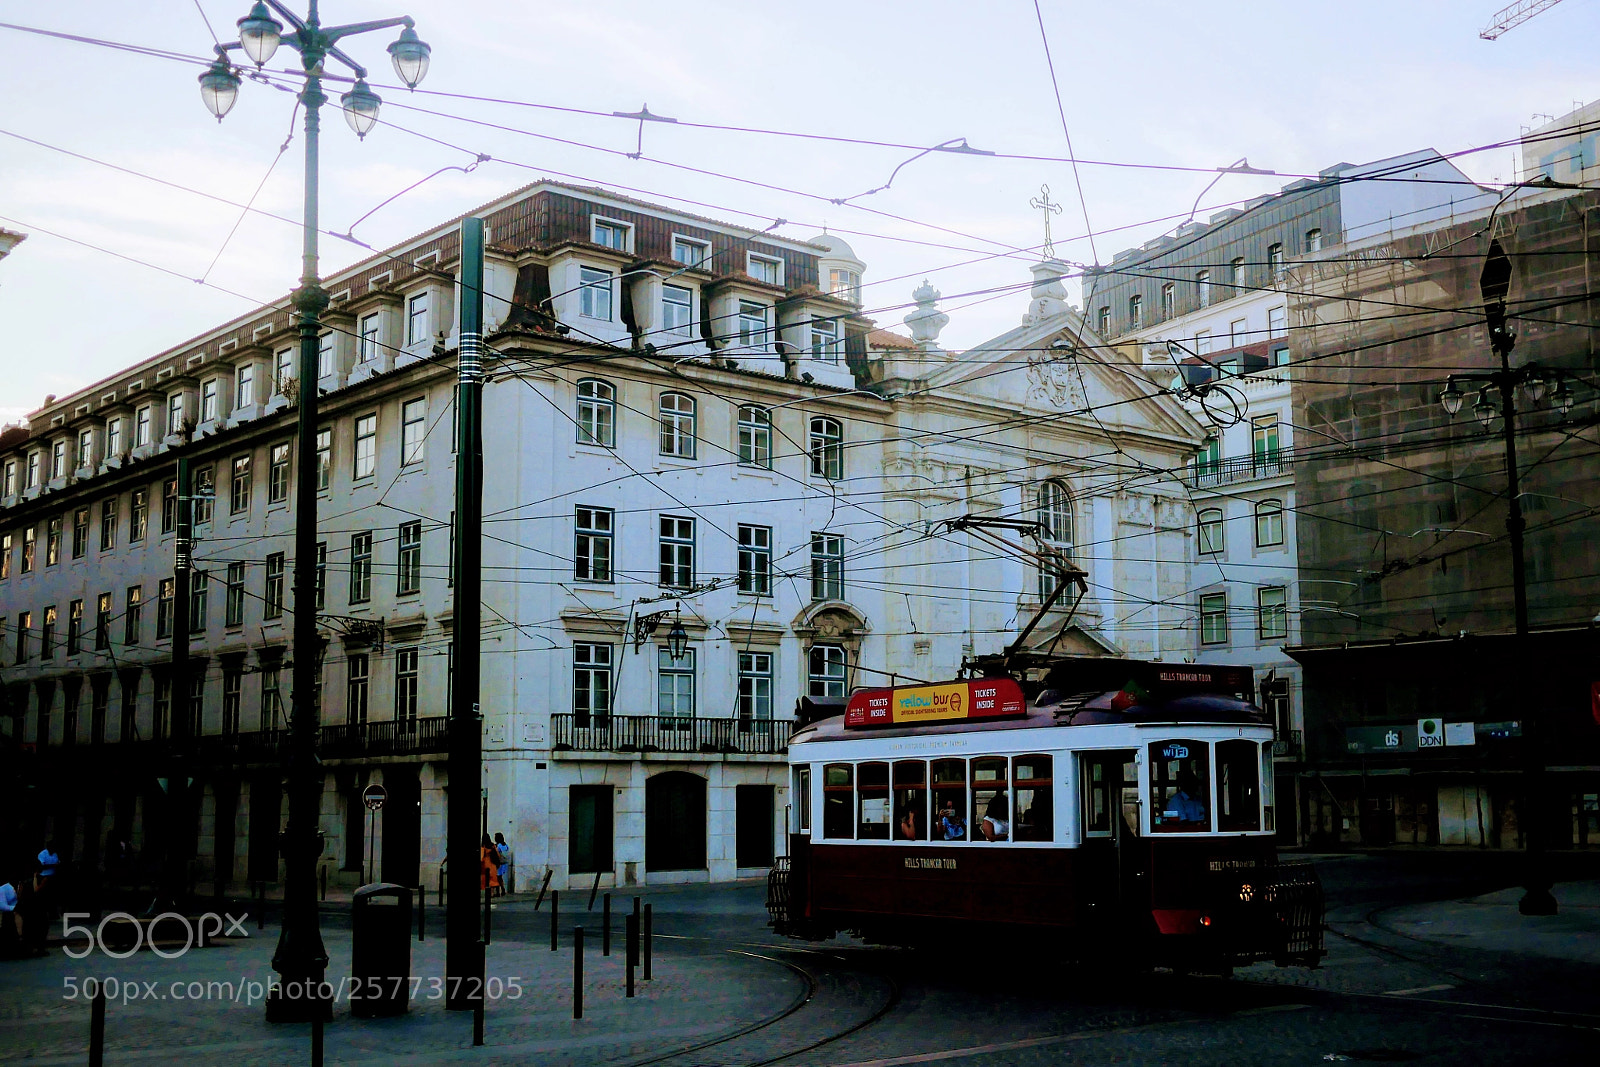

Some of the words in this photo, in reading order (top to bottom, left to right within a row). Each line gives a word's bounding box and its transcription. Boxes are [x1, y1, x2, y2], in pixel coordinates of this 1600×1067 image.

[1159, 672, 1175, 681] HILLS
[974, 688, 996, 698] TICKETS
[869, 698, 888, 707] TICKETS
[933, 691, 949, 706] bus
[976, 700, 995, 709] INSIDE
[870, 708, 886, 717] INSIDE
[1420, 736, 1442, 746] DDN
[904, 857, 920, 868] HILLS
